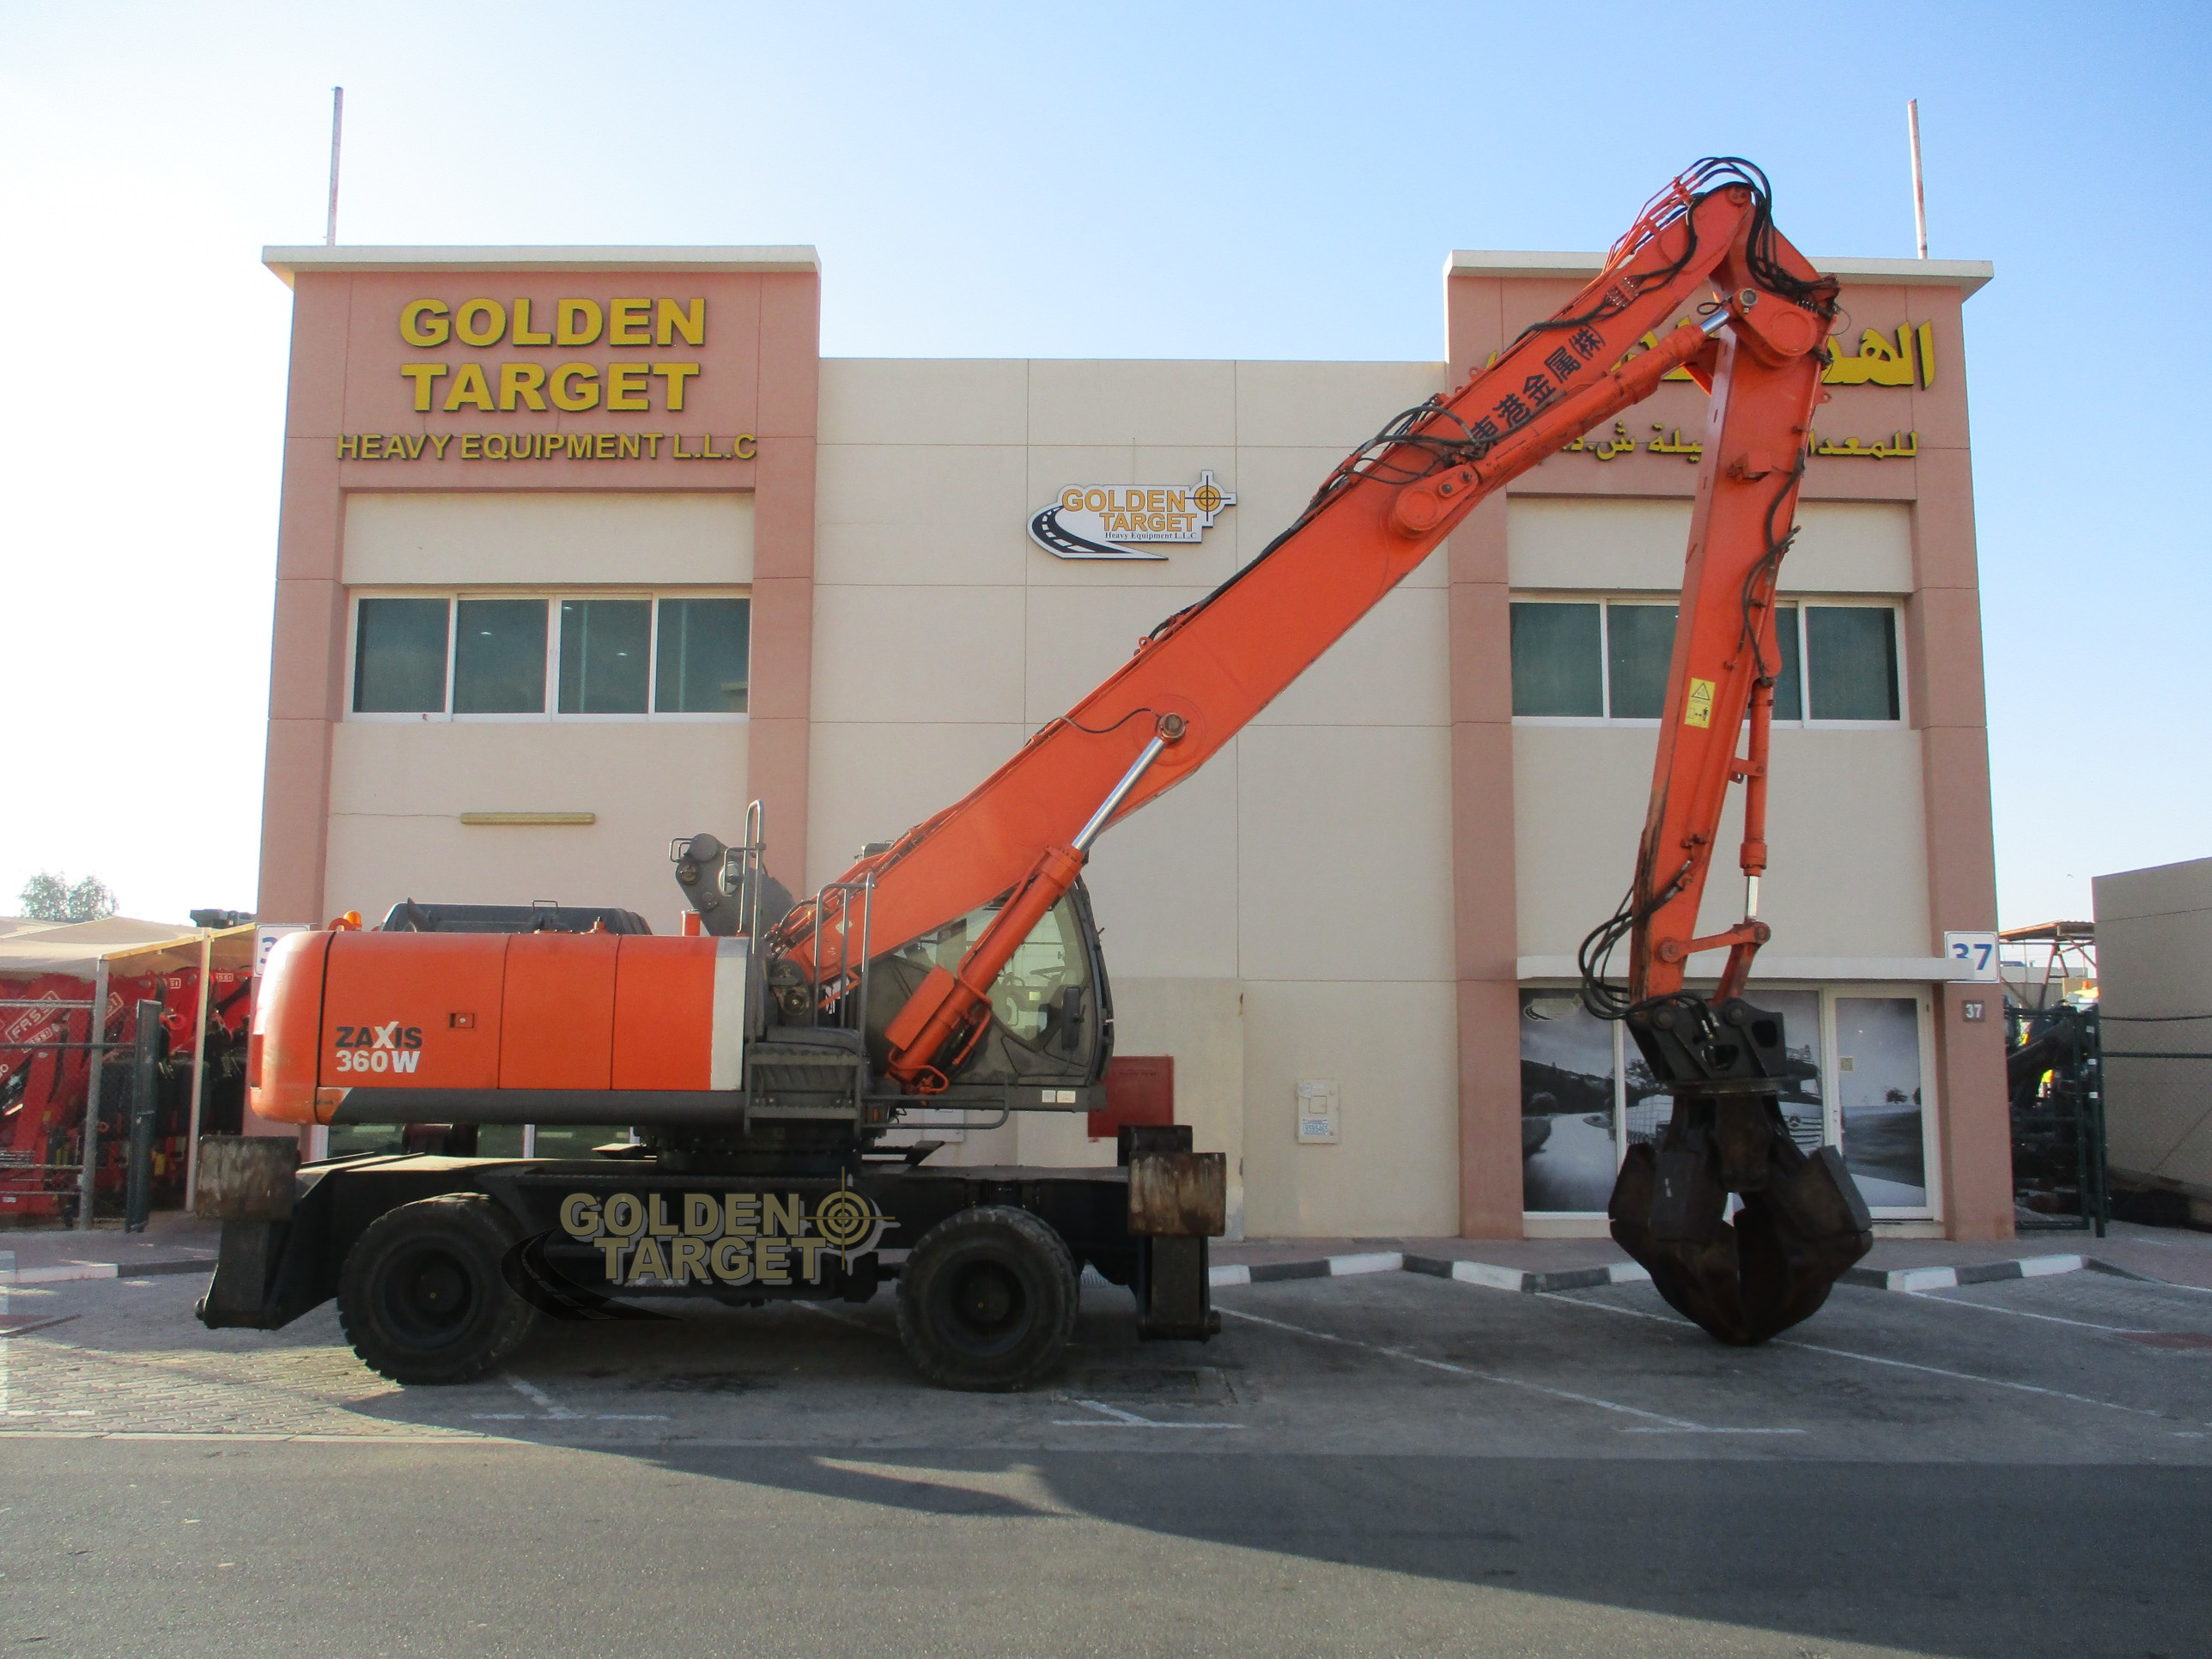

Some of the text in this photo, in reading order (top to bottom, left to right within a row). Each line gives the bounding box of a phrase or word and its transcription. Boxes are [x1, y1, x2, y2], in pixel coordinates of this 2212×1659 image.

[399, 297, 707, 348] GOLDEN
[1820, 319, 1936, 391] الهد
[400, 362, 701, 413] TARGET
[337, 432, 757, 461] HEAVY EQUIPMENT L.L.C
[1808, 428, 1919, 460] للمعدا
[1061, 489, 1186, 513] GOLDEN
[1099, 513, 1198, 532] TARGET
[1104, 531, 1129, 541] Heavy
[1130, 531, 1173, 541] Equipment
[1952, 943, 1993, 971] 37
[1965, 1003, 1983, 1018] 37
[335, 1021, 423, 1049] ZAXIS
